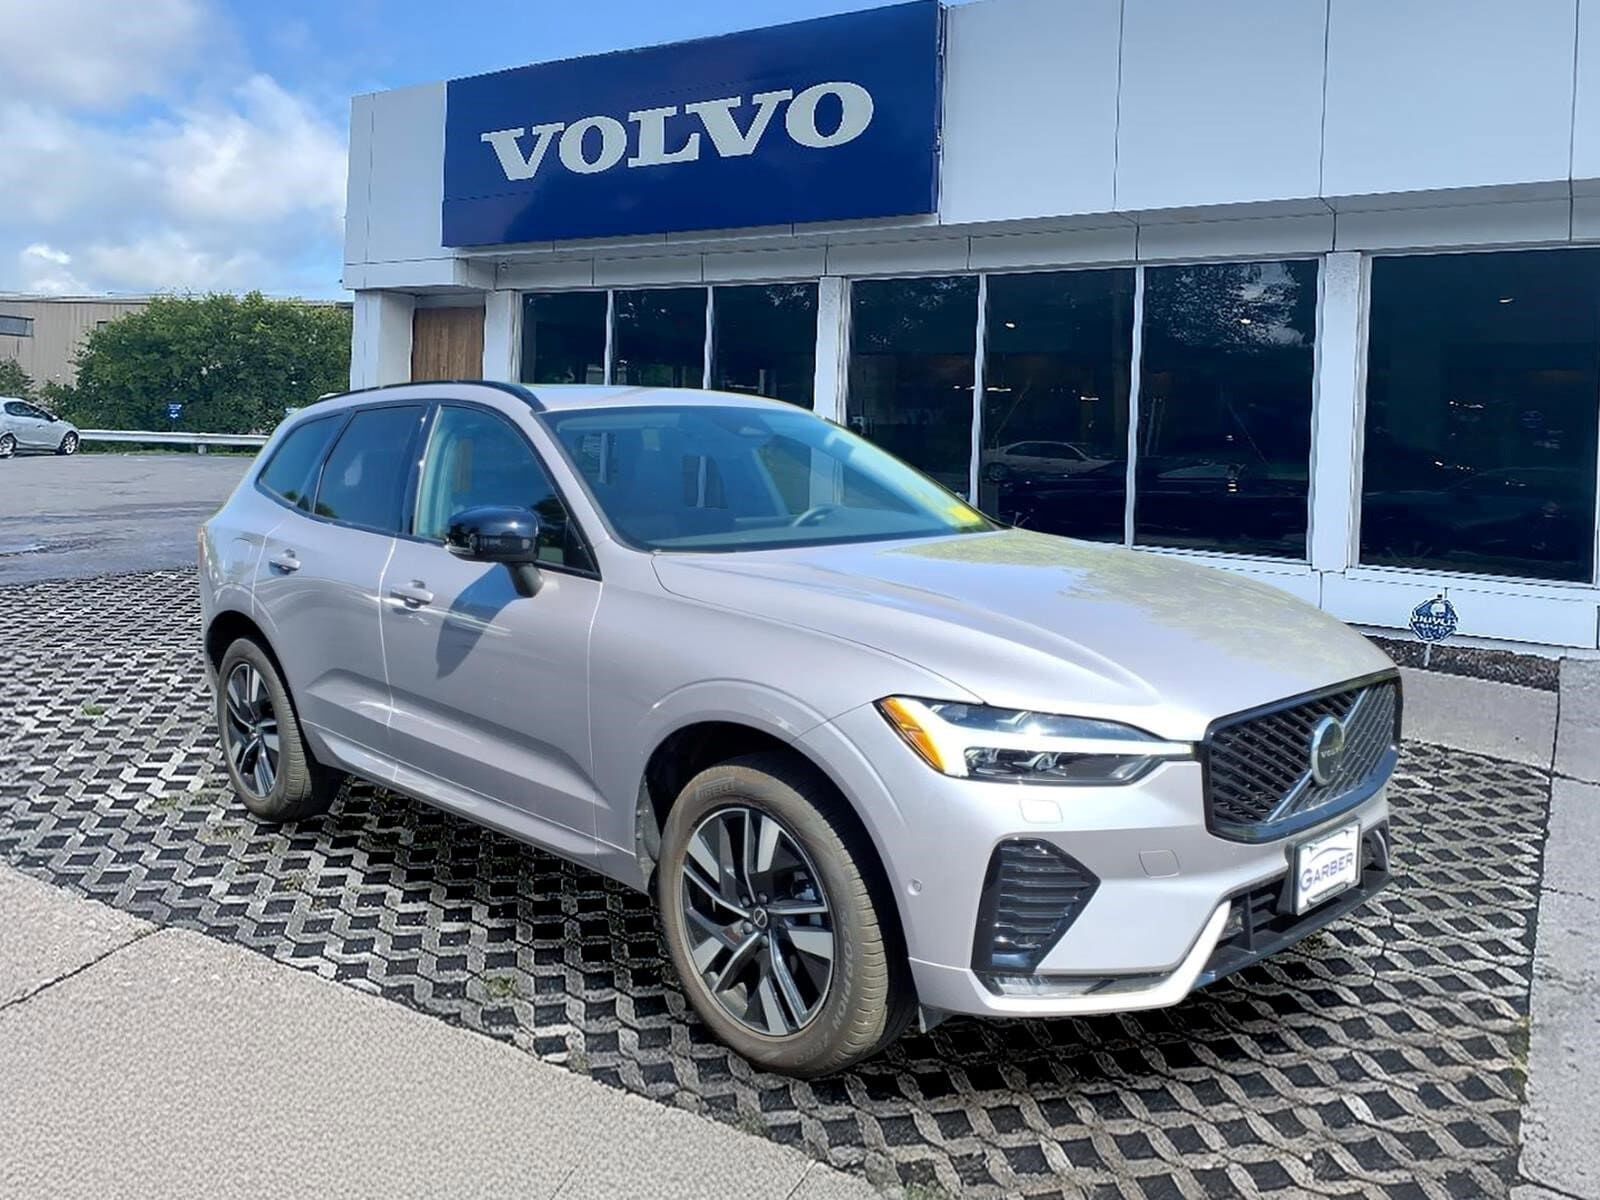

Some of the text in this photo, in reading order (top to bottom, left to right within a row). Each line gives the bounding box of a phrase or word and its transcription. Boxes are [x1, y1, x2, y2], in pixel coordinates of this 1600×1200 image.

[480, 81, 874, 181] VOLVO
[1301, 852, 1354, 892] GARBER
[831, 911, 854, 1031] SCORPION
